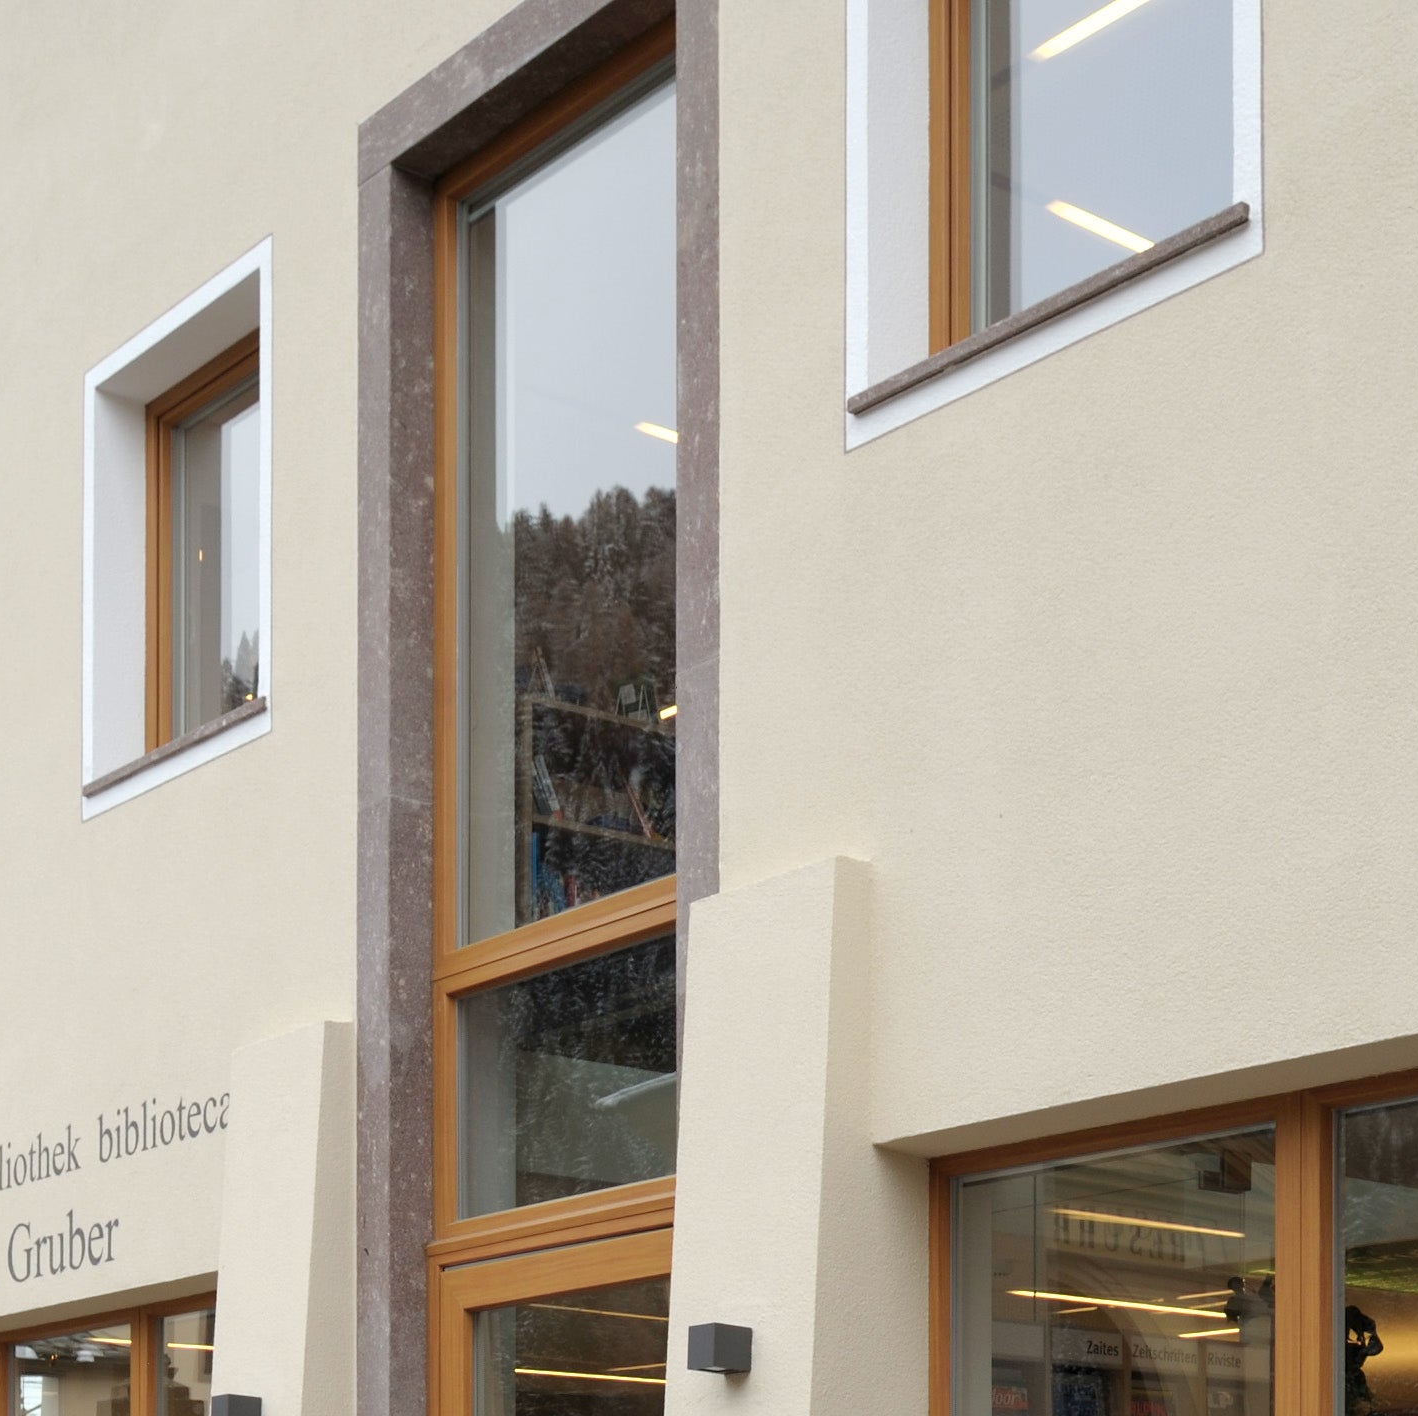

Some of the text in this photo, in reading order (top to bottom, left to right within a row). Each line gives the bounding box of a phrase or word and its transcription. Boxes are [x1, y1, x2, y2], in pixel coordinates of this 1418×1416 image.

[98, 1092, 231, 1163] biblioteca
[7, 1208, 119, 1283] Gruber
[1086, 1341, 1242, 1368] Zaites Zeitschriften Riviste
